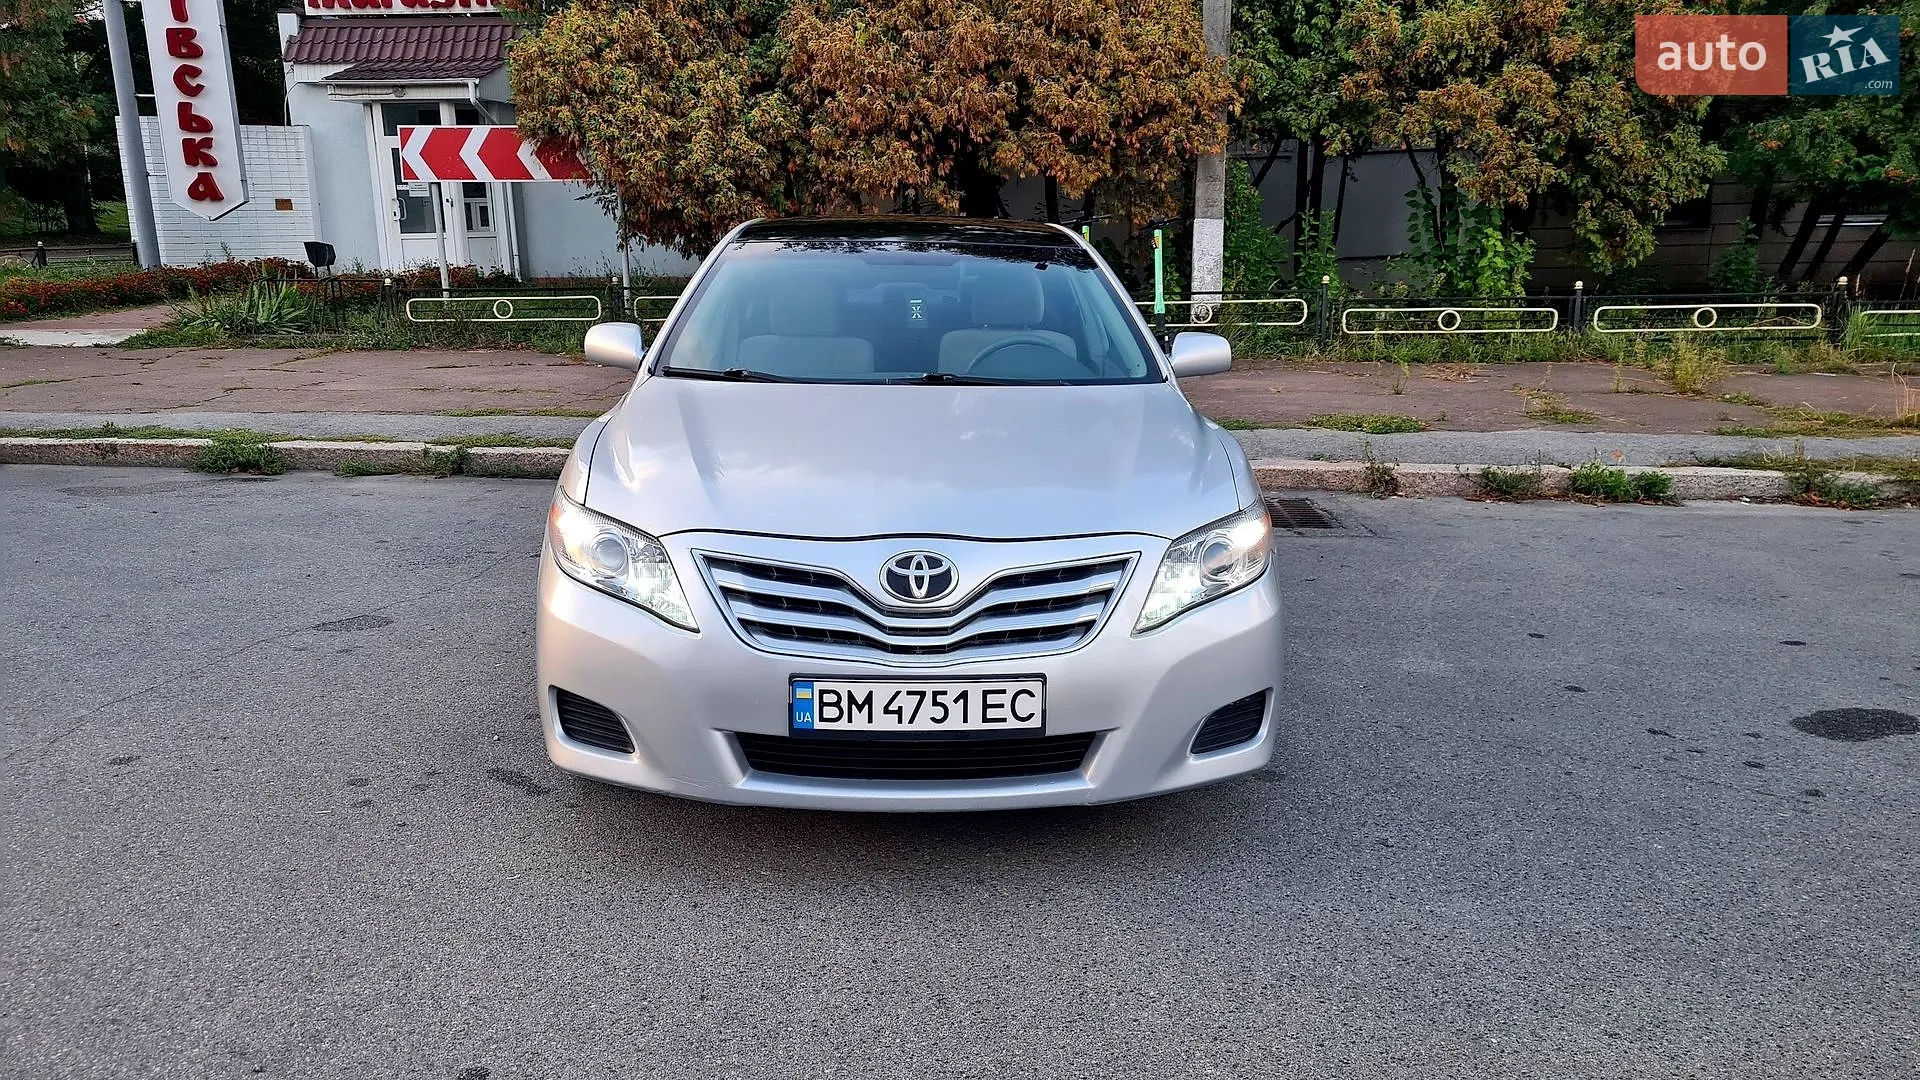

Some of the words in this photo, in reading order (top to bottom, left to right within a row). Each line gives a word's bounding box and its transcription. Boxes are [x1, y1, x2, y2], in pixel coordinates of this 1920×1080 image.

[795, 711, 813, 723] UA
[818, 689, 874, 724] BM
[883, 690, 970, 725] 4751
[981, 688, 1036, 724] EC
